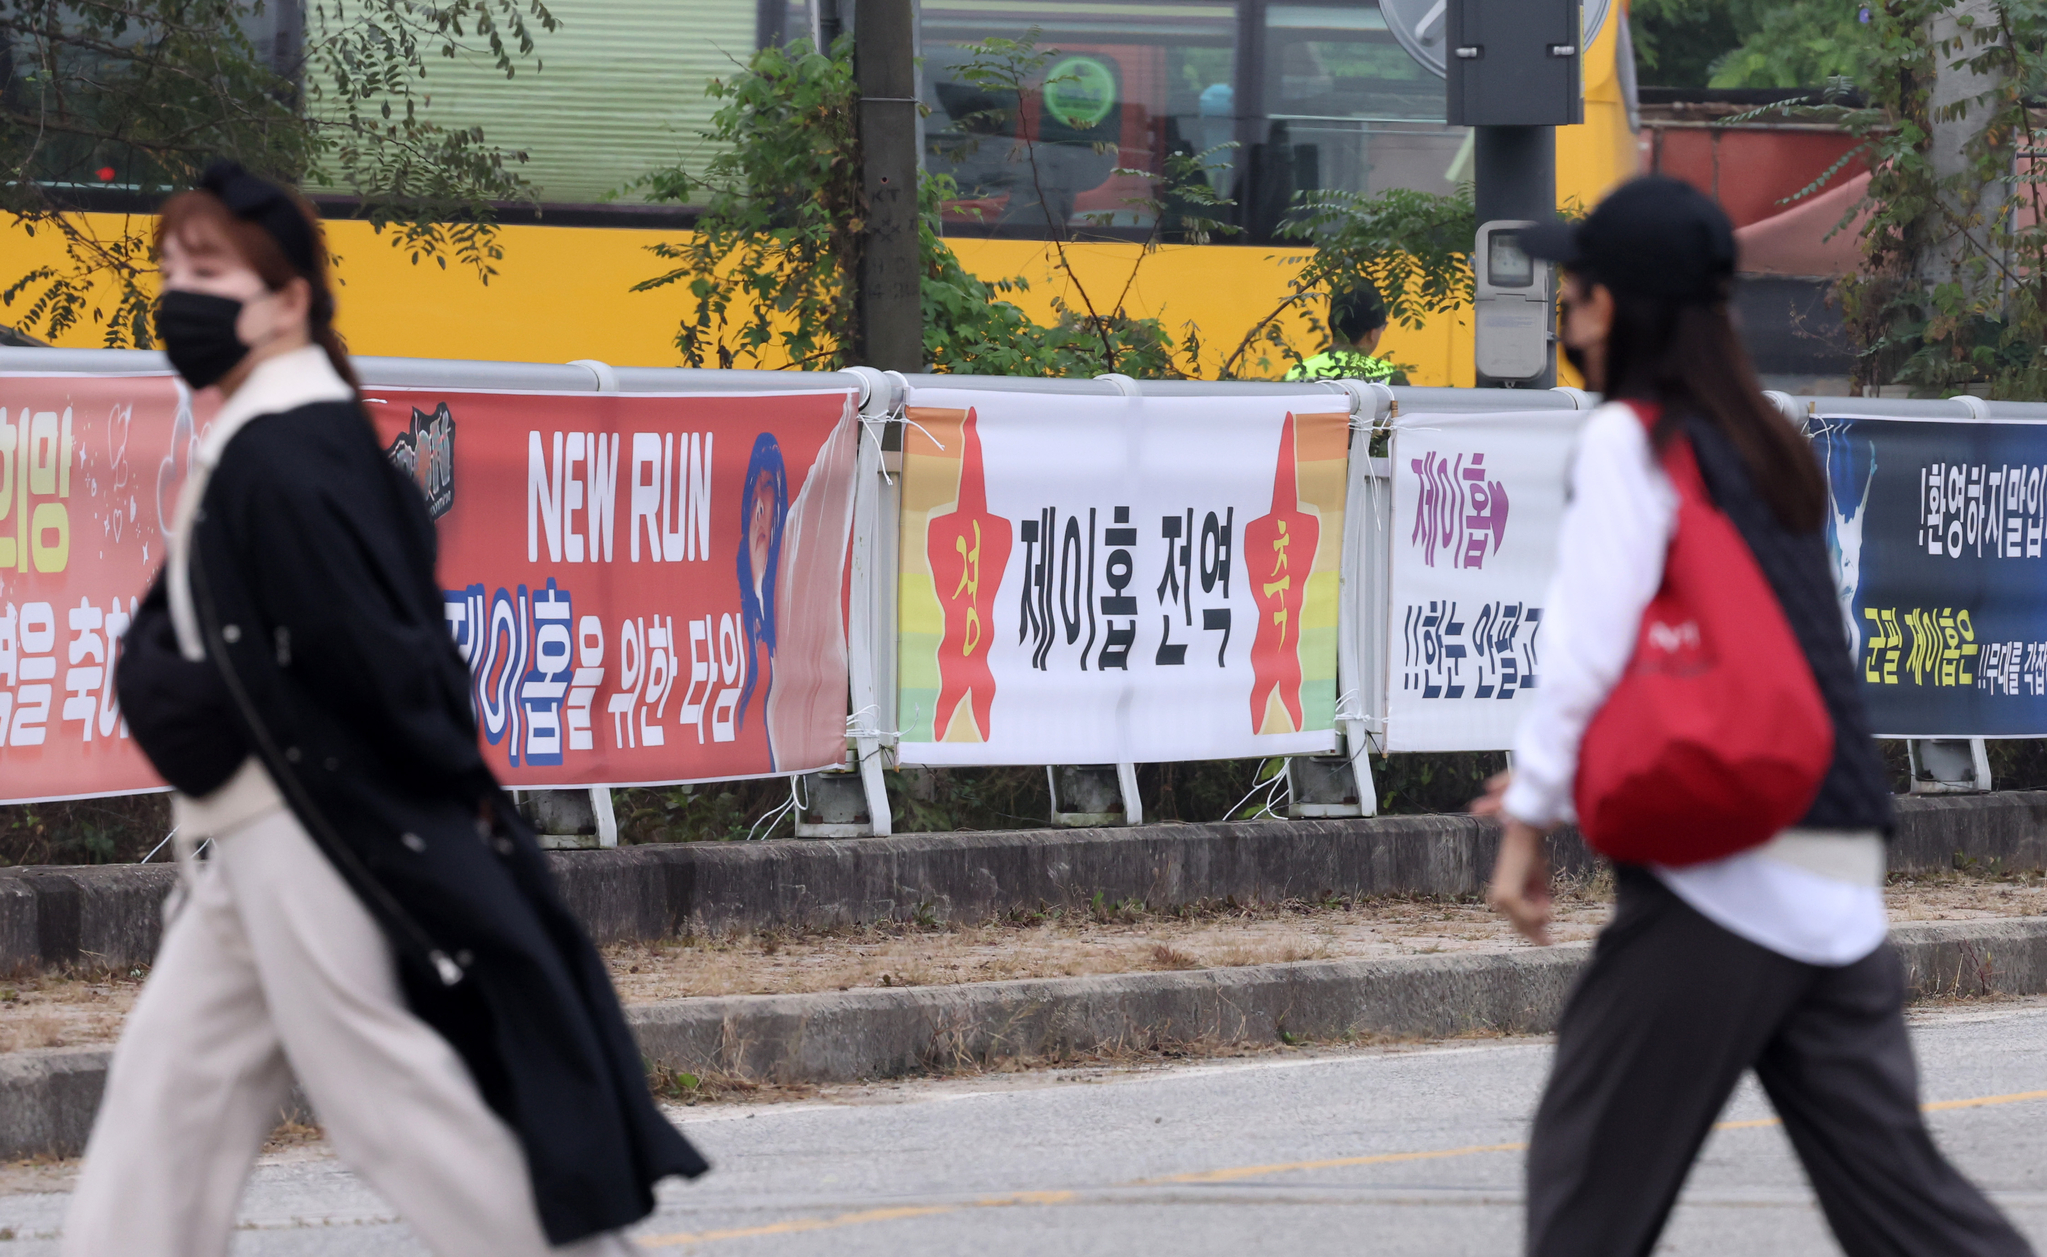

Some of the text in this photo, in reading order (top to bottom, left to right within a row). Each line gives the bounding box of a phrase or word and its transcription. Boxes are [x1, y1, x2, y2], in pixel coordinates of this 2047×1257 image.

[527, 430, 619, 563] NEW
[631, 431, 713, 562] RUN
[1411, 451, 1491, 569] 제이홉
[1919, 462, 2047, 558] !환영하지말입
[1019, 506, 1234, 671] 제이홉 전역
[1263, 519, 1290, 653] 축
[1864, 607, 1904, 685] 군필
[608, 614, 678, 749] 위한
[680, 612, 746, 746] 타임
